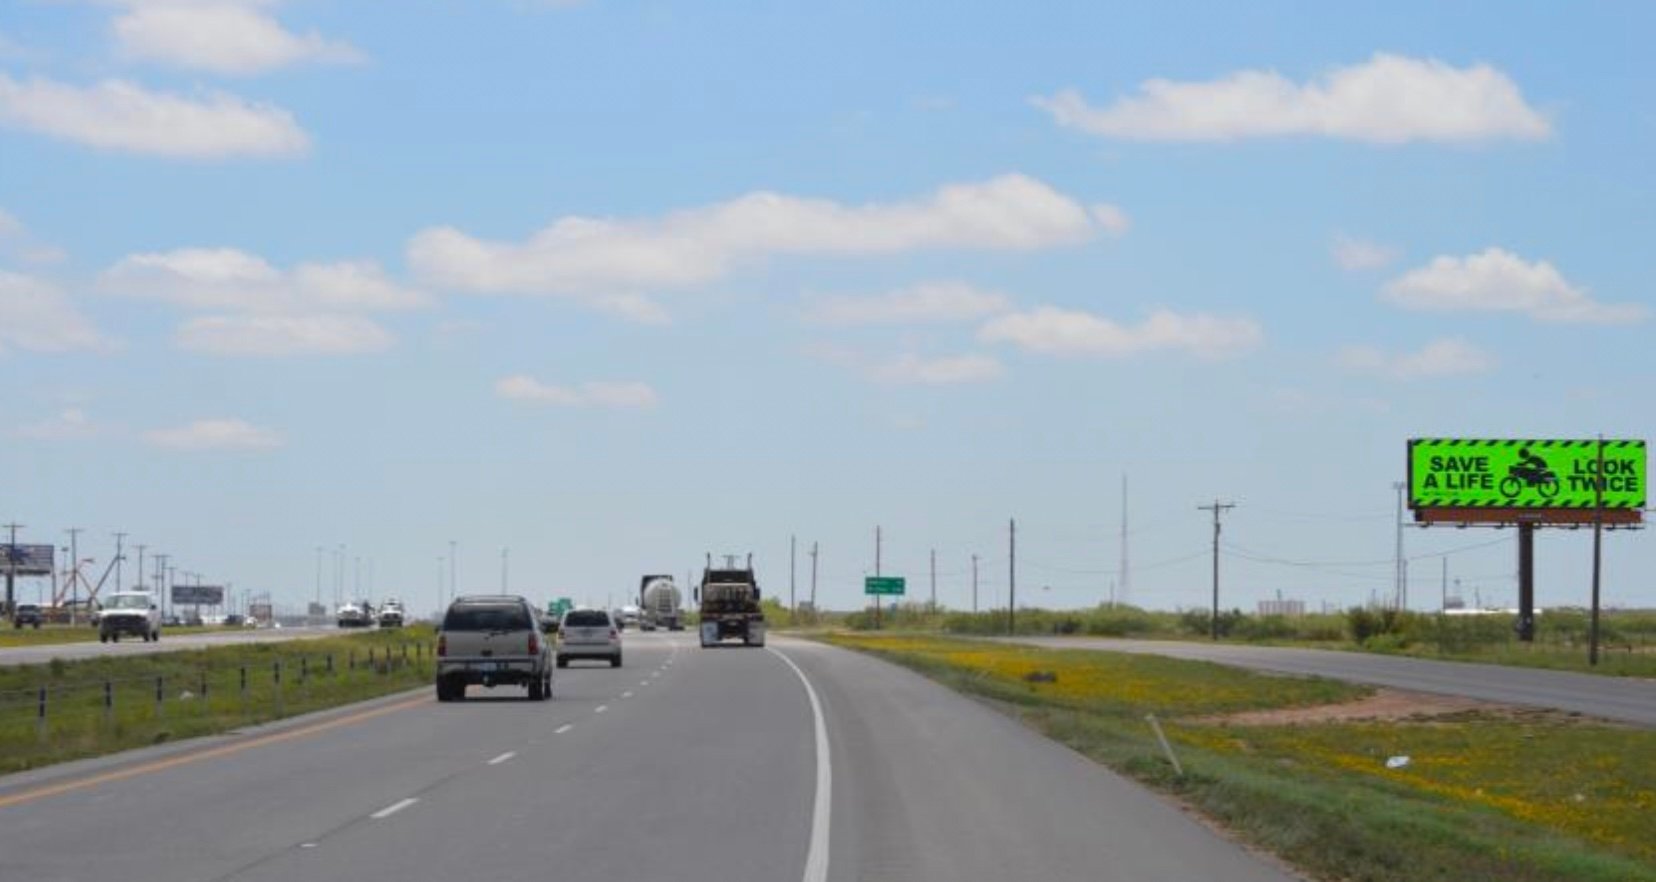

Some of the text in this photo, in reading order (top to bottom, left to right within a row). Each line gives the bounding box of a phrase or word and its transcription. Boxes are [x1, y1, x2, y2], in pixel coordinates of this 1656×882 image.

[1430, 456, 1489, 472] SAVE
[1574, 459, 1635, 475] LOOK
[1423, 473, 1494, 489] A LIFE
[1567, 476, 1638, 491] TWICE
